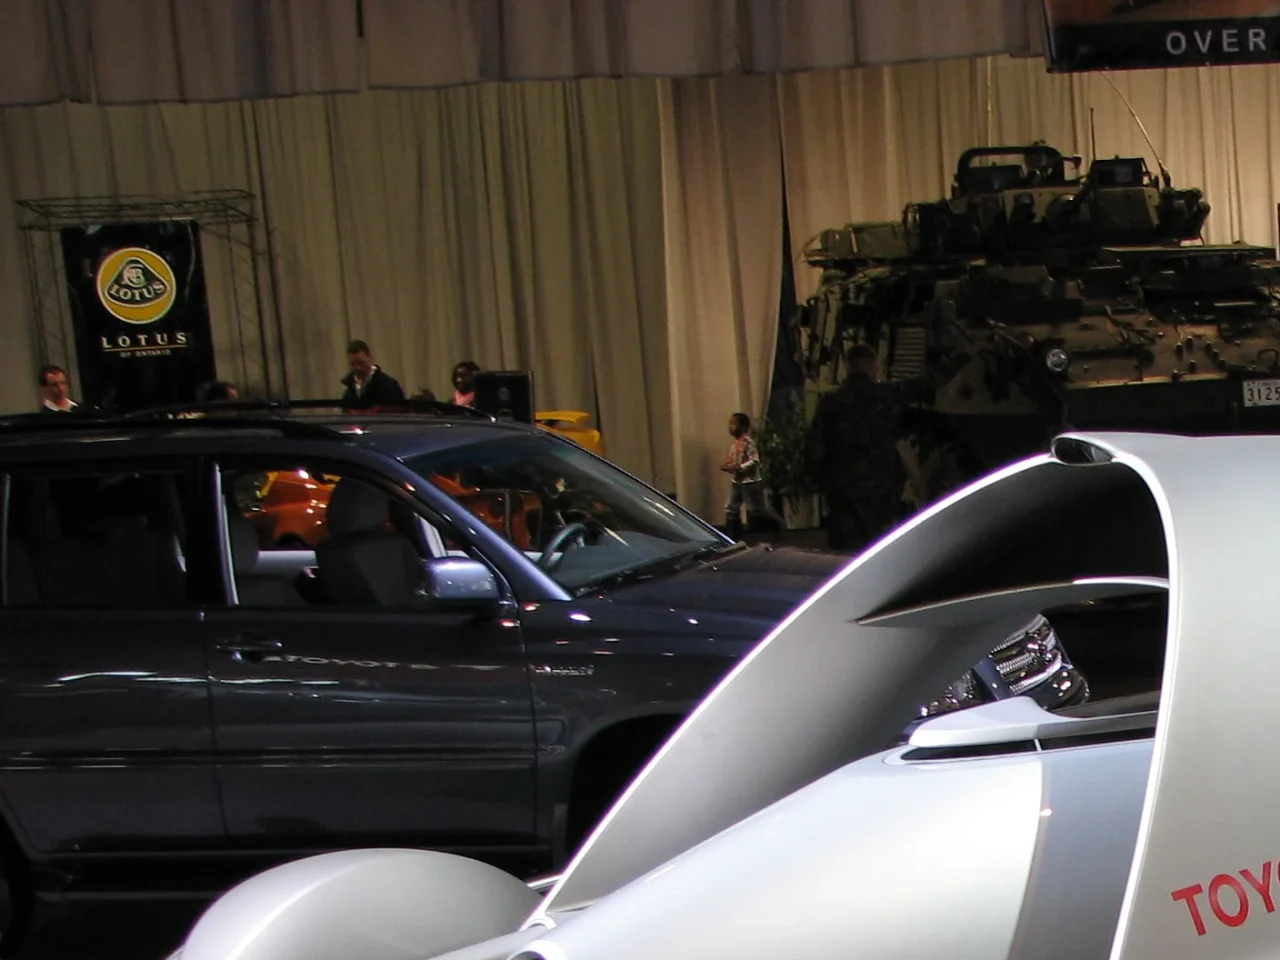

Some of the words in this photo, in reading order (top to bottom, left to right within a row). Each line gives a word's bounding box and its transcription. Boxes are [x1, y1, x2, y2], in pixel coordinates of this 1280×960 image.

[1165, 28, 1268, 55] OVER
[109, 281, 165, 300] LOTUS
[100, 332, 187, 348] LOTUS
